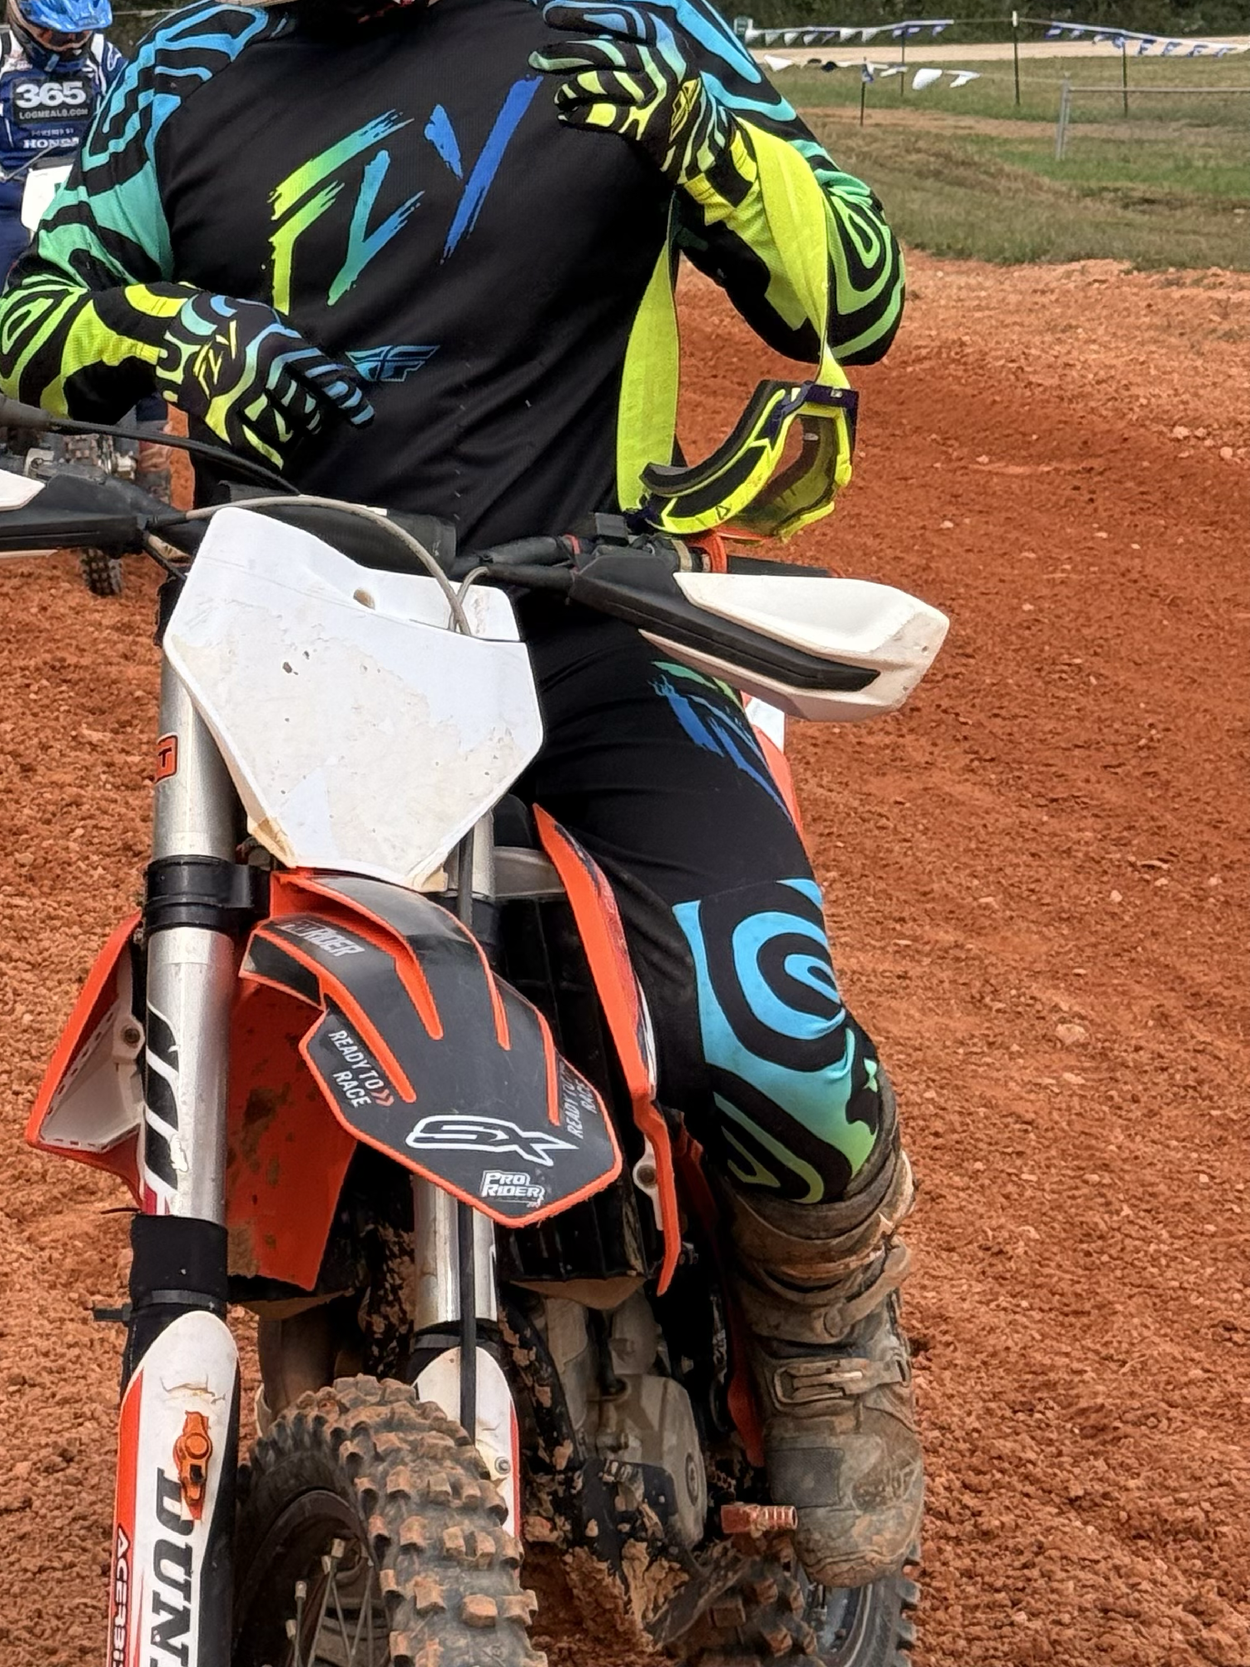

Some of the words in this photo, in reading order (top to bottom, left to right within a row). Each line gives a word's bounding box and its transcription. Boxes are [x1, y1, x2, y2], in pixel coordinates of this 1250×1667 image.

[15, 81, 86, 108] 365
[266, 75, 544, 315] FLY
[328, 1030, 371, 1069] READY
[359, 1069, 384, 1090] TO
[333, 1071, 372, 1107] RACE
[564, 1094, 584, 1139] READY
[405, 1115, 579, 1167] SX
[481, 1184, 543, 1197] RIDER
[484, 1172, 527, 1185] PRO
[150, 1467, 195, 1667] DUN
[111, 1523, 131, 1667] ACERBI
